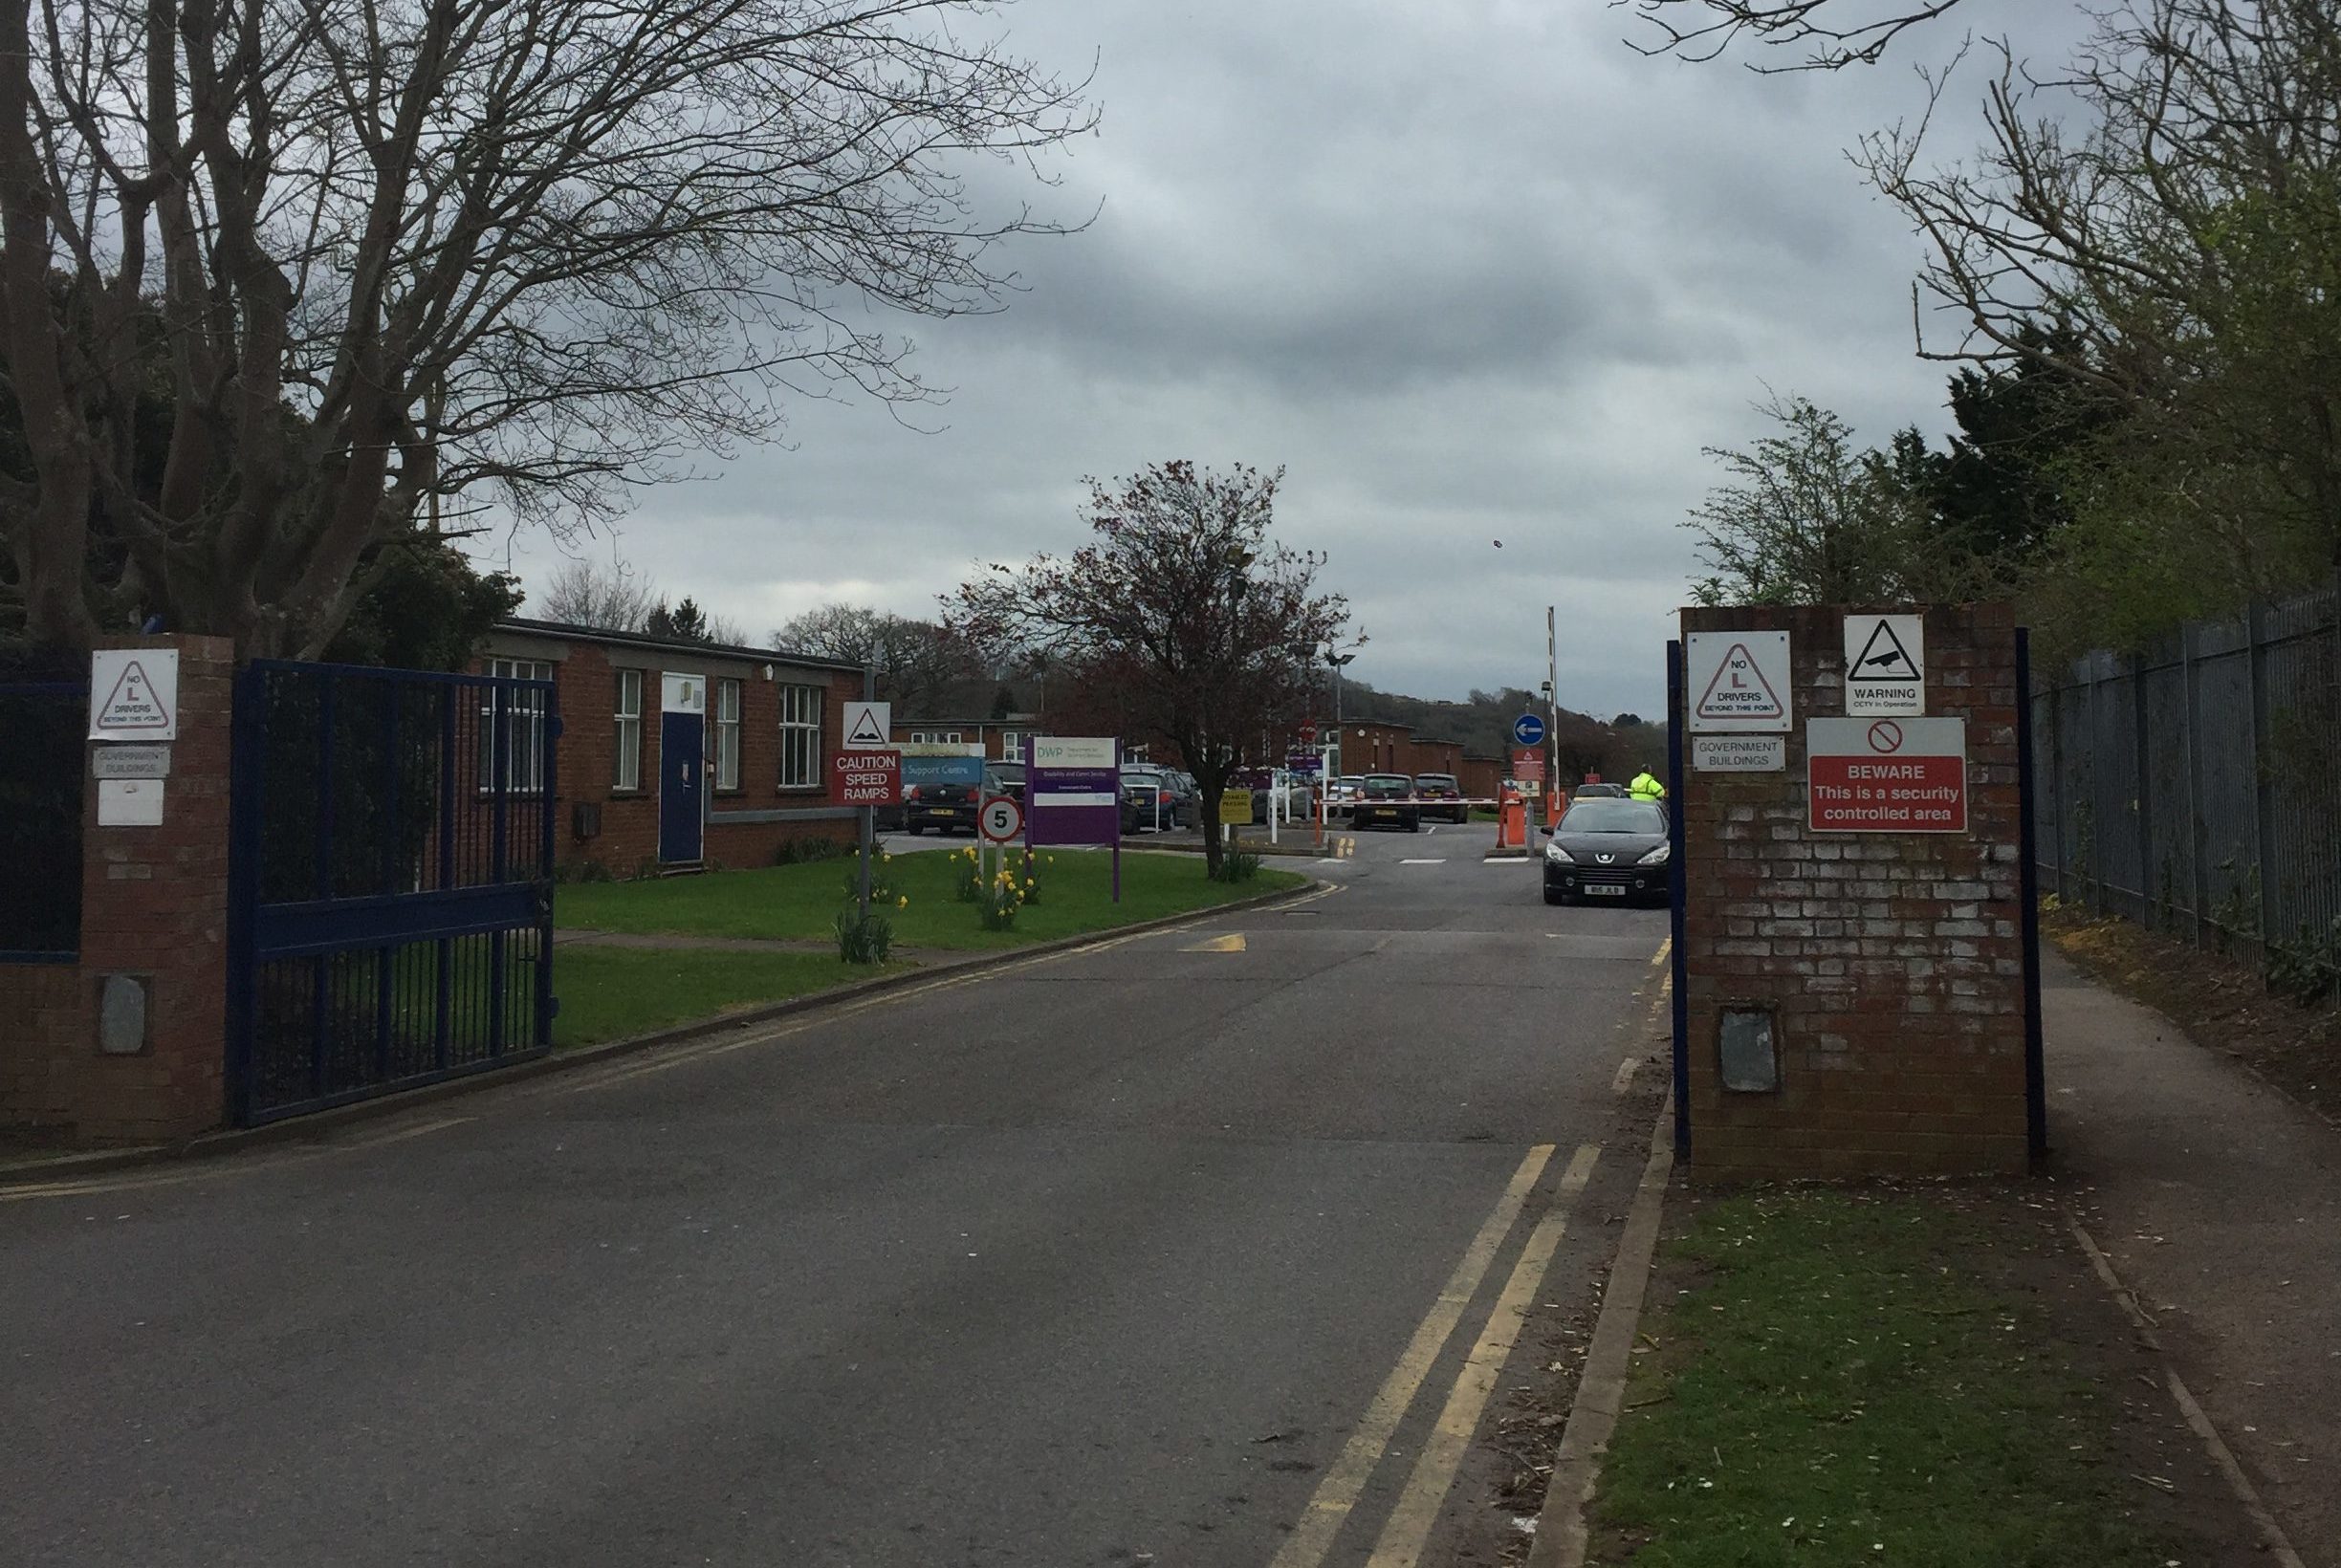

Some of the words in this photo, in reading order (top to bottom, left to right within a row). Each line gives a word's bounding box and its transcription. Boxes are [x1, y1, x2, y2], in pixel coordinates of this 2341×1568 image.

[1731, 661, 1746, 669] NO
[1732, 673, 1746, 688] L
[127, 687, 140, 701] L
[1854, 688, 1915, 699] WARNING
[115, 705, 151, 713] DRIVERS
[1038, 747, 1062, 758] DWP
[1699, 742, 1778, 752] GOVERNMENT
[98, 751, 164, 761] GOVERNMENT
[1708, 754, 1769, 766] BUILDINGS
[106, 763, 155, 773] BUILDINGS
[837, 755, 896, 770] CAUTION
[908, 765, 939, 775] Support
[1848, 766, 1925, 779] BEWARE
[845, 773, 887, 786] SPEED
[843, 787, 889, 800] RAMPS
[1815, 785, 1852, 799] This
[1856, 785, 1871, 799] is
[1876, 789, 1886, 799] a
[1891, 786, 1958, 803] security
[994, 811, 1008, 828] 5
[1824, 807, 1910, 820] controlled
[1914, 810, 1951, 820] area
